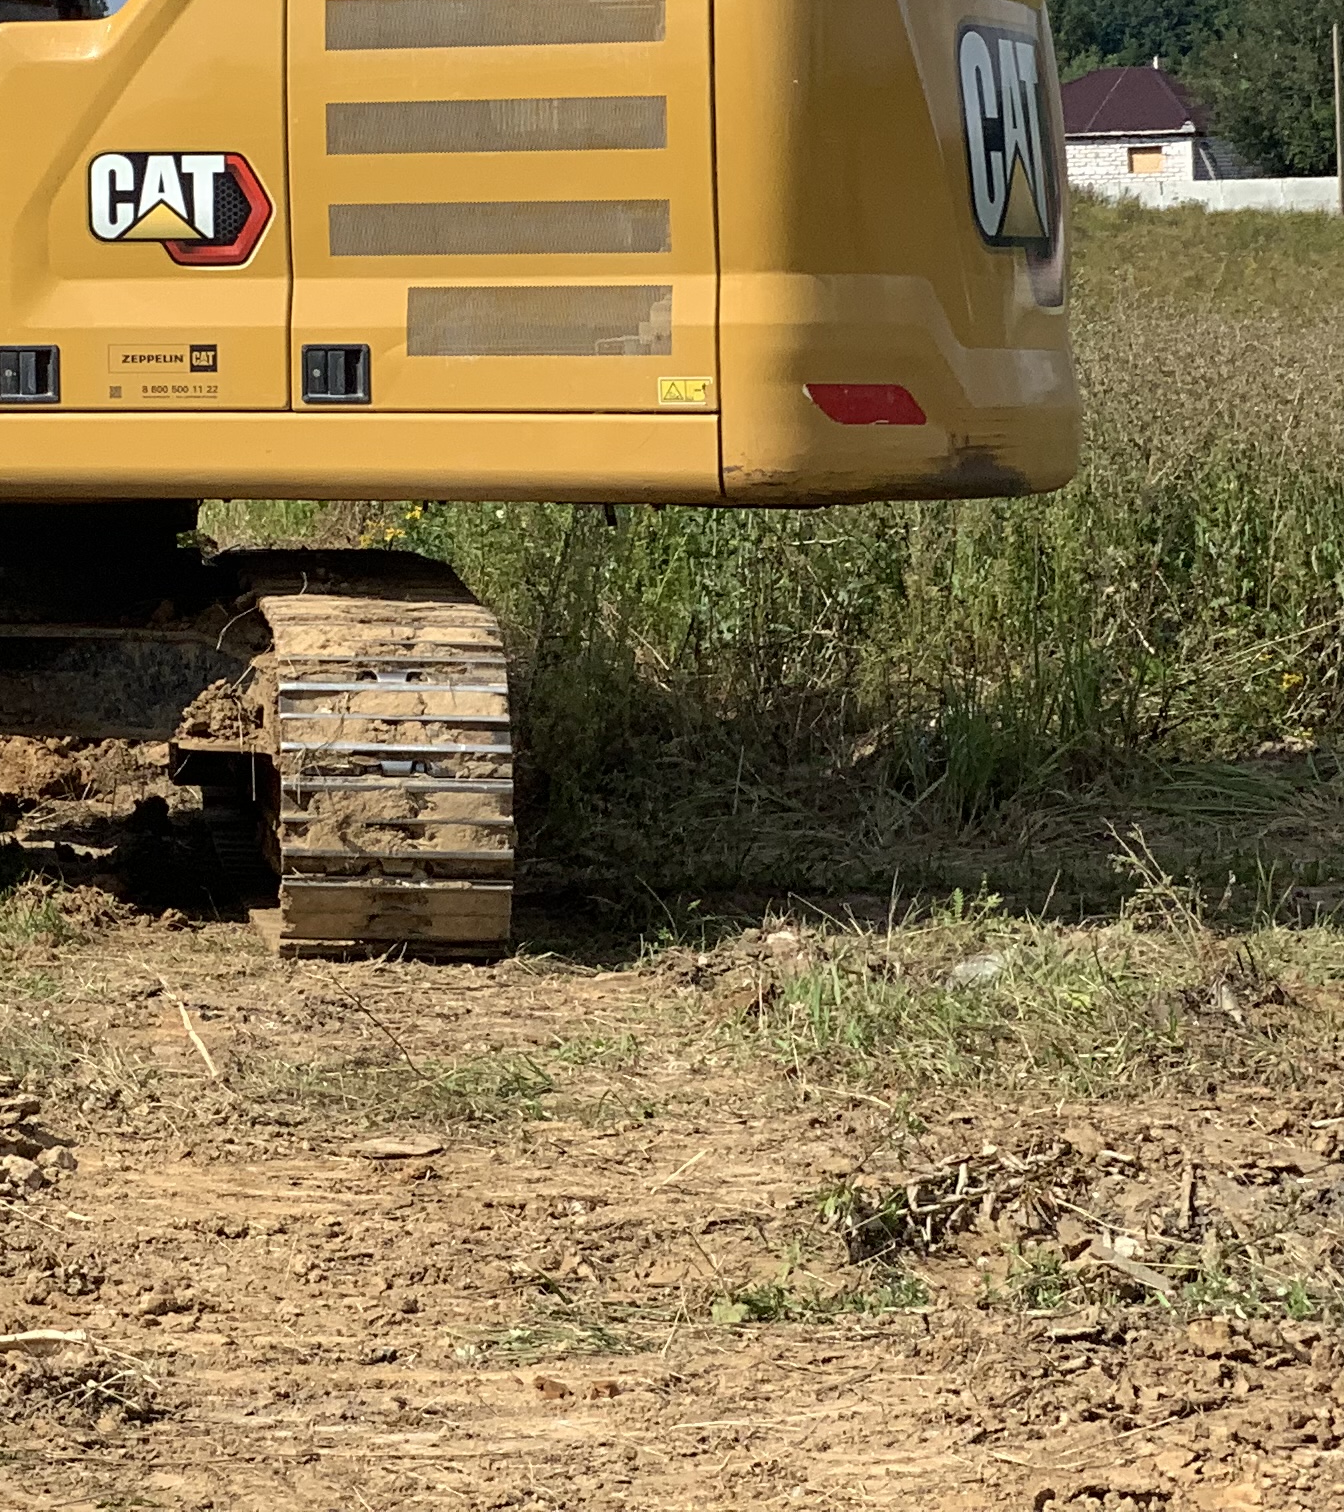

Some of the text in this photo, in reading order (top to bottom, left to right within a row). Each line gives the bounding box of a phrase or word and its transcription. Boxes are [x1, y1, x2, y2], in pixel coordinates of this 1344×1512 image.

[960, 31, 1050, 238] CAT
[91, 153, 226, 239] CAT
[121, 351, 215, 366] ZEPPELIN CAT
[141, 385, 149, 394] 8
[171, 385, 189, 394] 500
[193, 385, 203, 394] 11
[206, 385, 218, 394] 22
